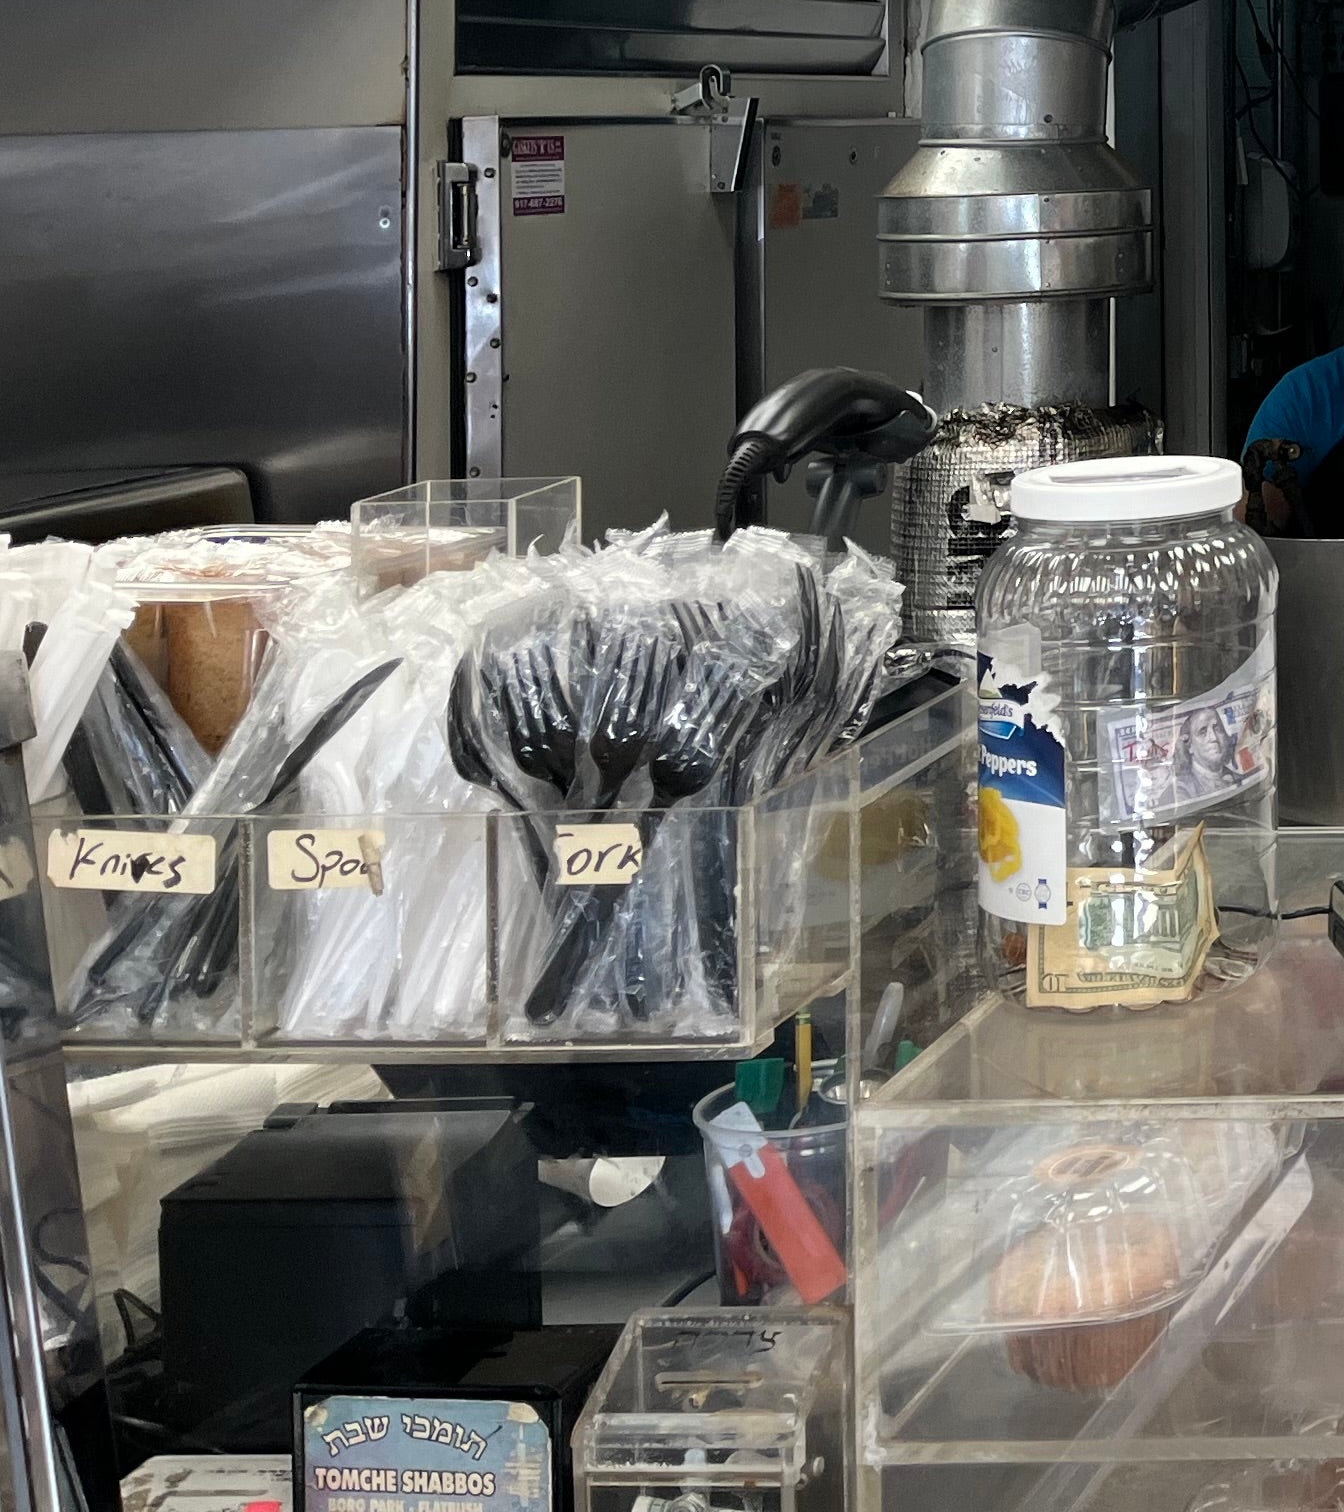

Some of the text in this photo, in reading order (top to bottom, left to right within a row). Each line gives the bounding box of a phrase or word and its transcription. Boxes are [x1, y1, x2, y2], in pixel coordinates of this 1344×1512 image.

[980, 743, 1038, 777] Peppers
[321, 1412, 489, 1461] תומכי שבת
[314, 1466, 497, 1498] TOMCHE SHABBOS
